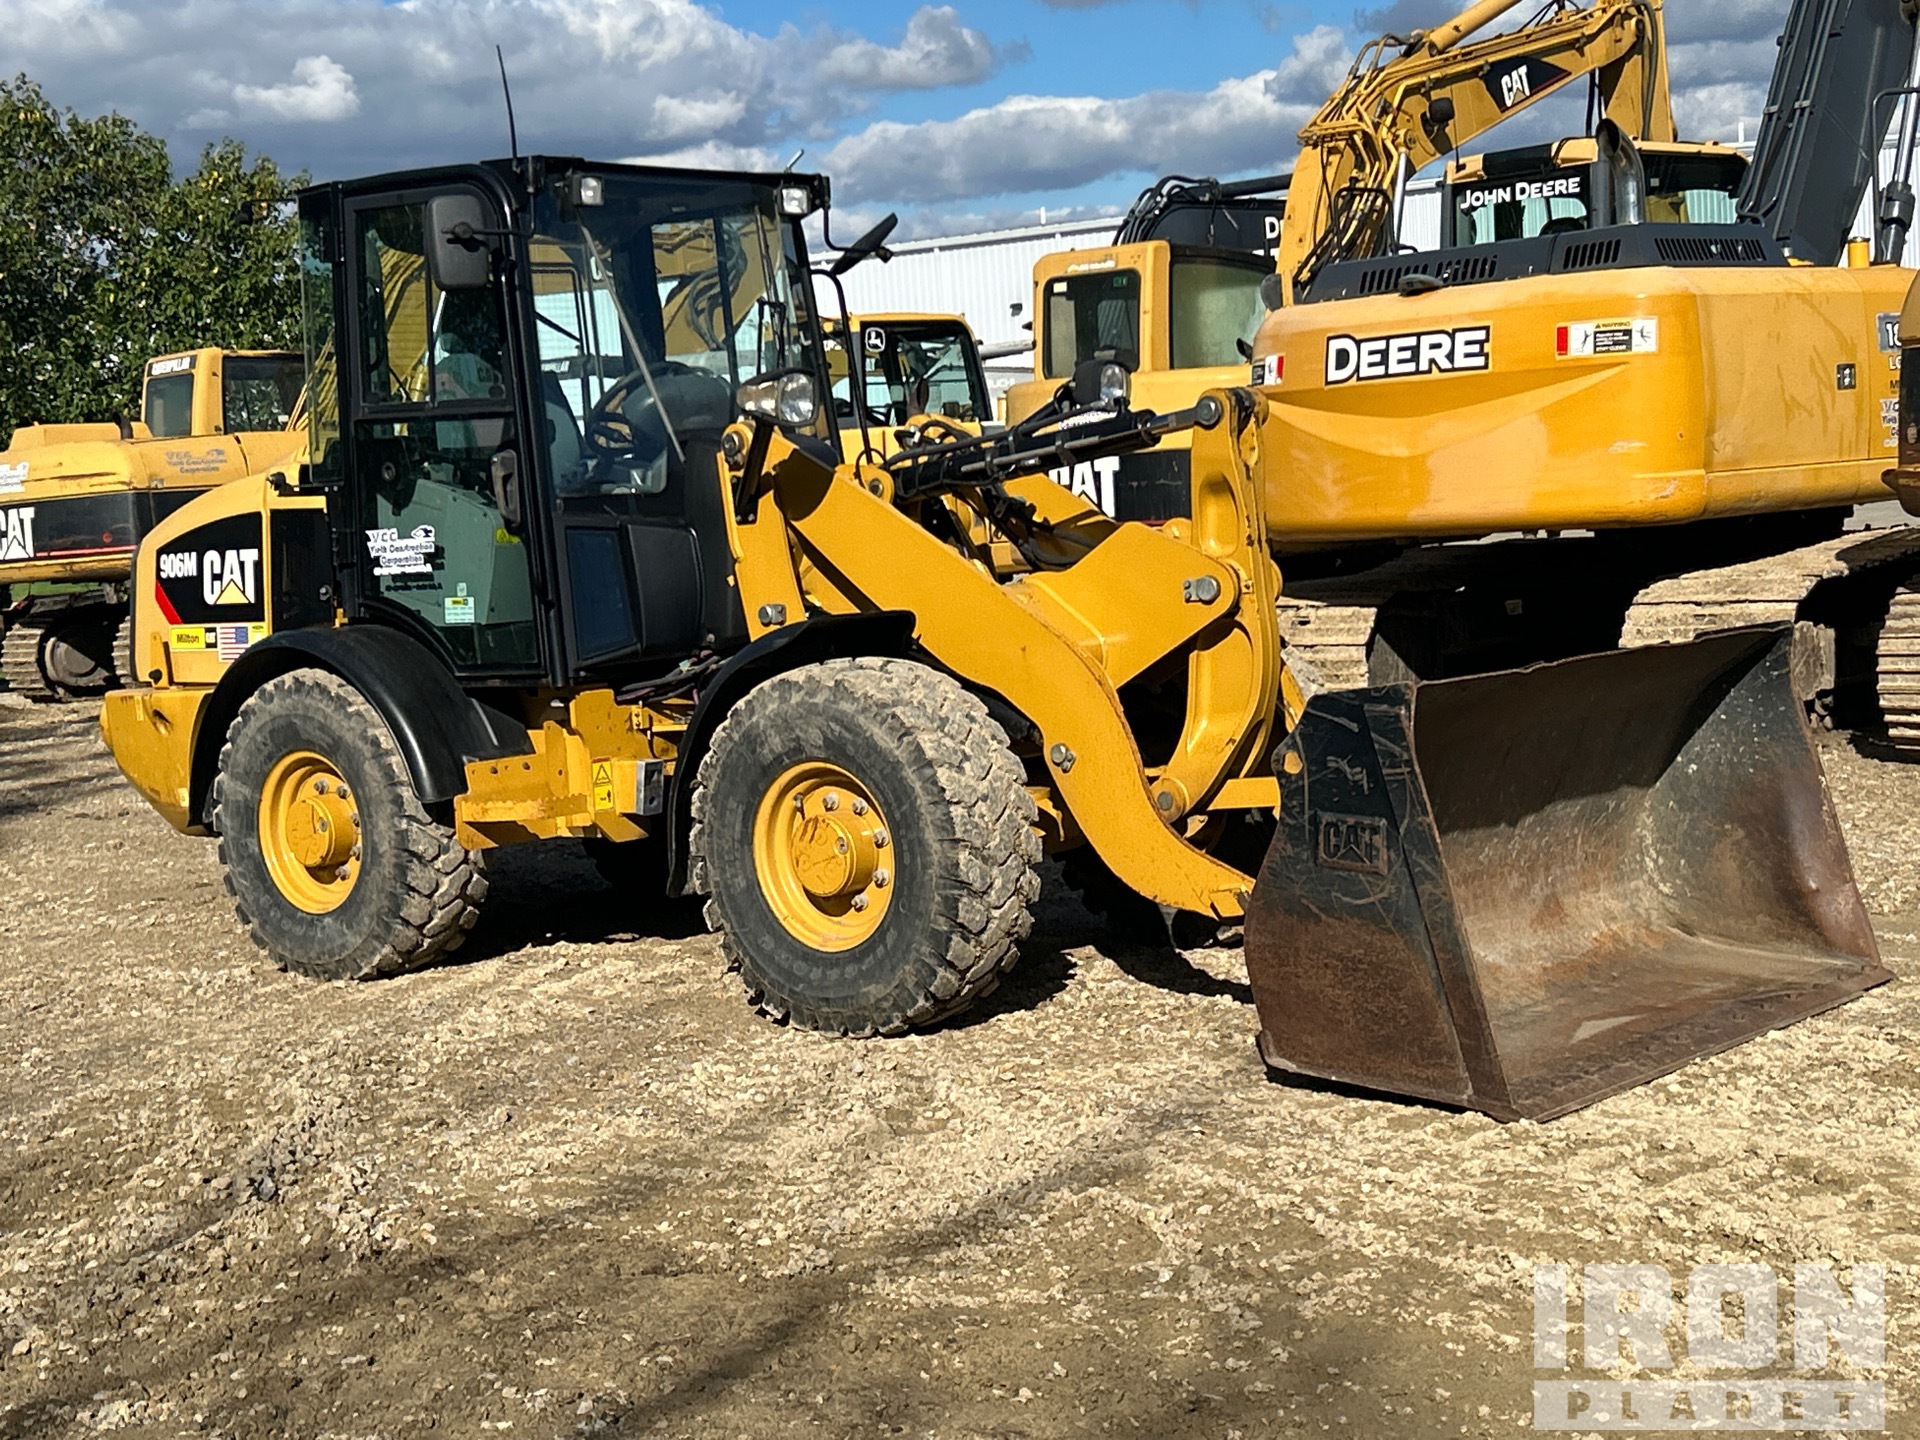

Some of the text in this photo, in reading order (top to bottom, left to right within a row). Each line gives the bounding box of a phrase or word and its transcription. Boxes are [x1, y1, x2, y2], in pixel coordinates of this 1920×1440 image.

[1501, 64, 1531, 107] CAT
[1460, 177, 1581, 209] JOHN DEERE
[1326, 328, 1489, 384] DEERE
[160, 548, 259, 605] 906M CAT
[1323, 821, 1381, 864] CAT
